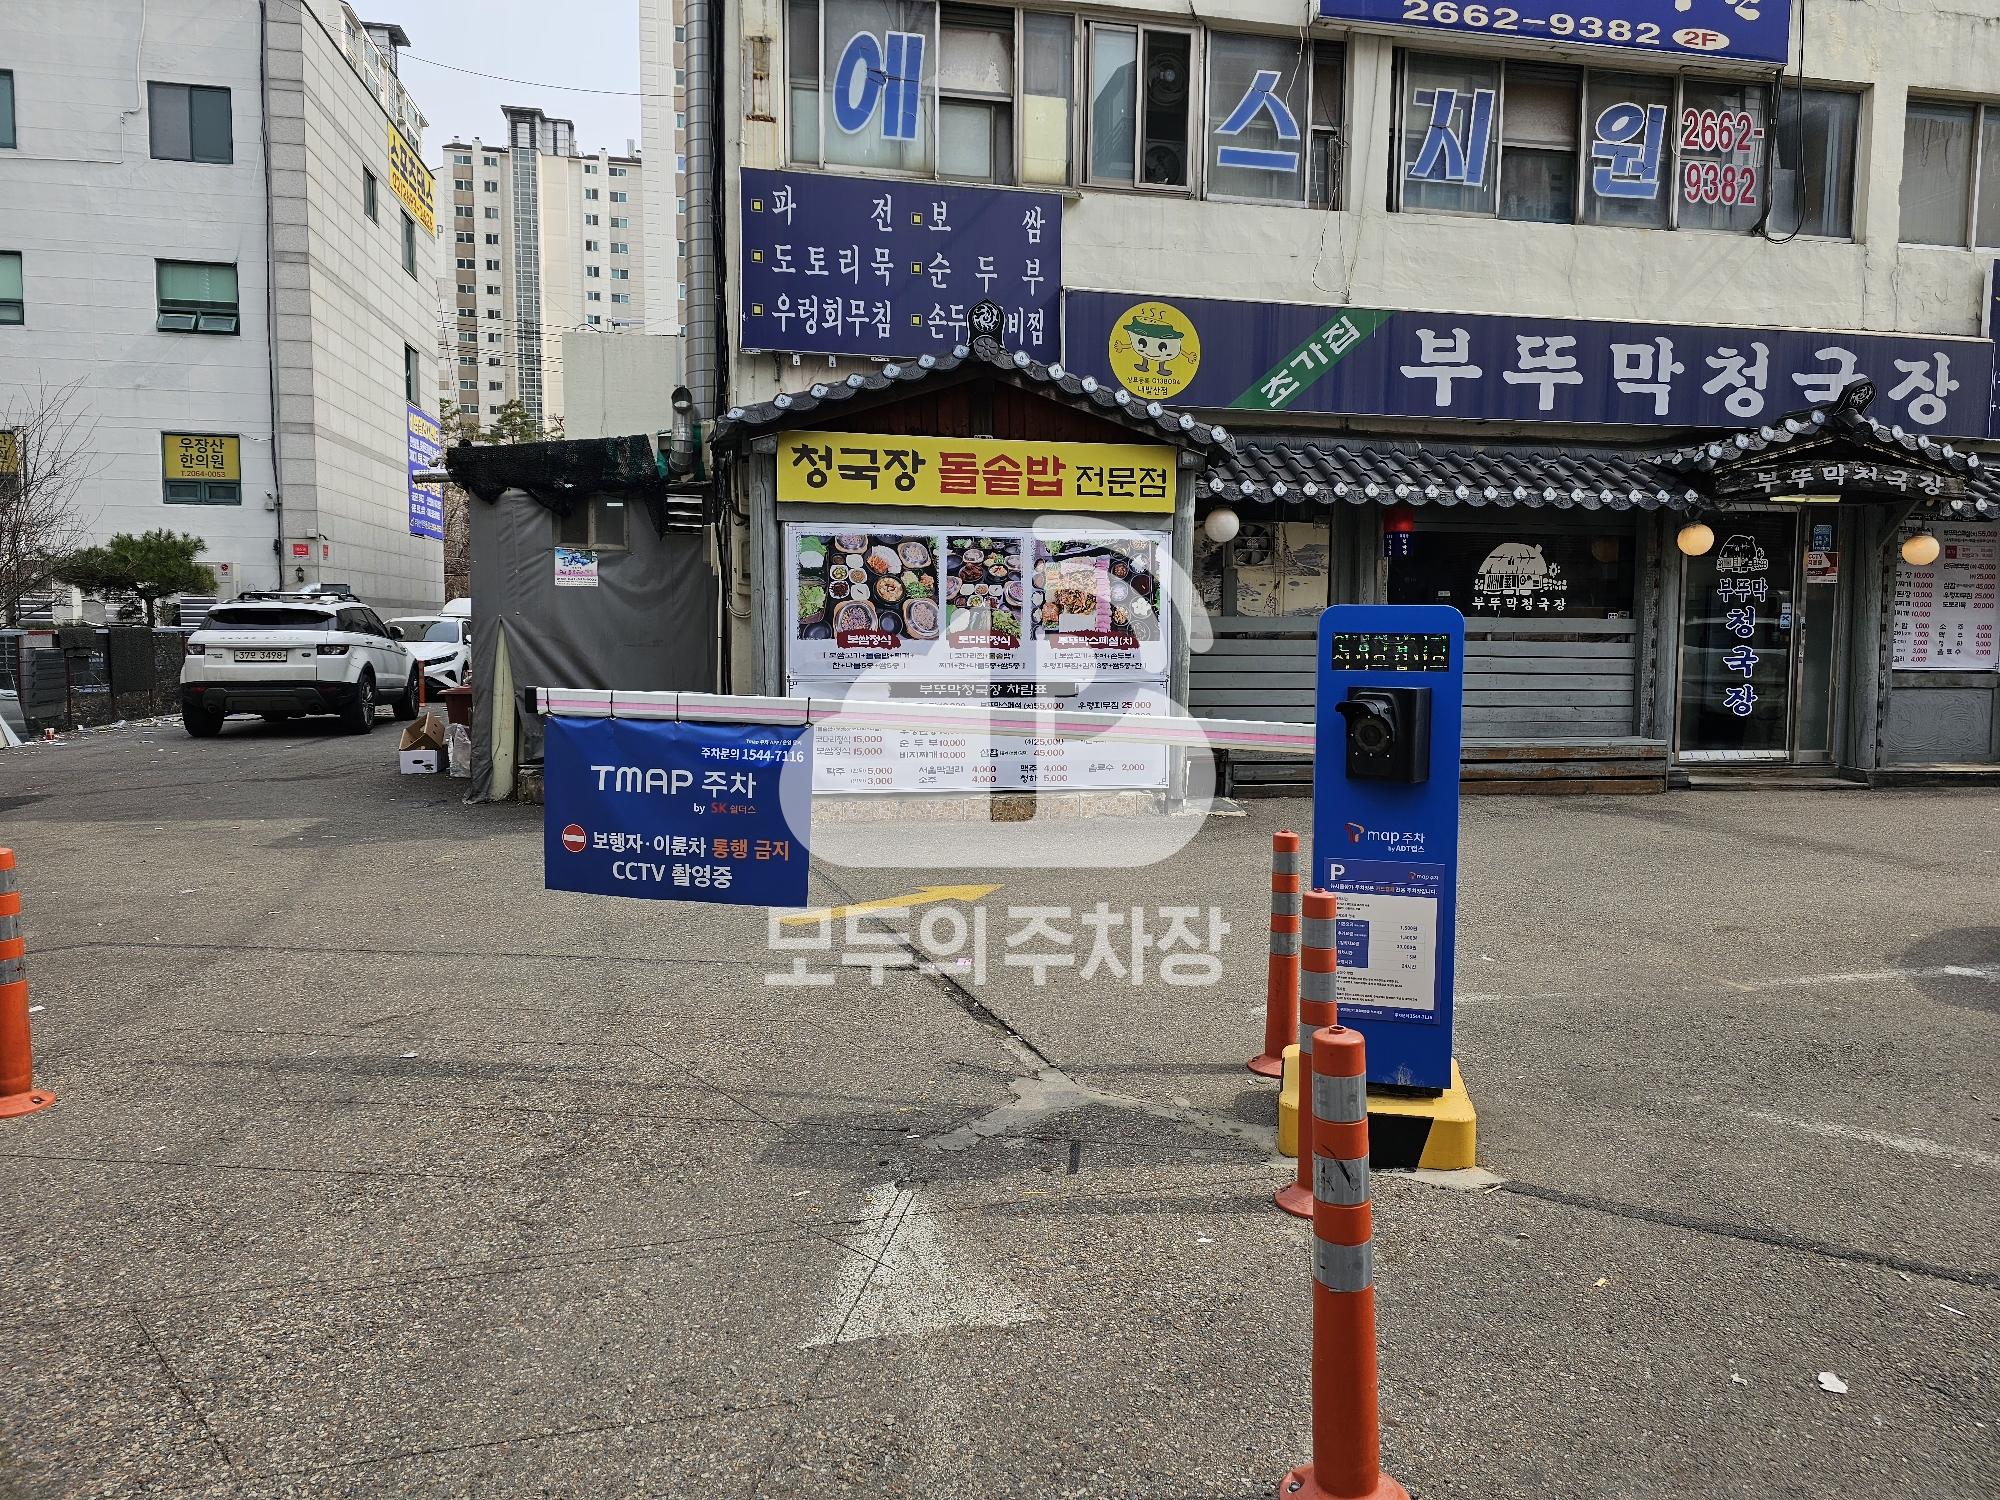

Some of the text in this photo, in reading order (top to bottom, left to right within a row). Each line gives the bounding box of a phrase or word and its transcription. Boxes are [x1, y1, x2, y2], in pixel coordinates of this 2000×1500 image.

[1402, 0, 1661, 45] 2662-9382
[1683, 30, 1719, 48] 2F
[1681, 108, 1764, 153] 2662-
[1685, 161, 1756, 206] 9382
[771, 245, 894, 286] 도토리묵
[772, 293, 891, 339] 우렁회무침
[1260, 316, 1360, 407] 초가집
[179, 438, 224, 453] 우장산
[180, 453, 224, 469] 한의원
[790, 443, 1168, 499] 청국장 돌솥밥 전문점
[1717, 577, 1768, 602] 부뚜막
[1472, 596, 1567, 611] 부뚜막청국장
[847, 635, 892, 645] 보쌈정식
[958, 635, 1011, 646] 코다리정식
[260, 652, 283, 660] 3498
[1723, 606, 1759, 716] 청국장
[919, 684, 1048, 697] 부뚜막청국장 차림표
[939, 739, 966, 747] 10,000
[701, 747, 804, 763] 주차문의 1544-7116
[853, 748, 882, 756] 15,000
[1020, 765, 1037, 773] 맥주
[591, 765, 757, 798] TMAP 주차
[1020, 775, 1037, 783] 청하
[694, 803, 705, 814] by
[711, 802, 727, 814] SK
[1402, 832, 1426, 844] 주차
[712, 838, 748, 859] 통행
[754, 839, 789, 861] 금지
[612, 860, 733, 888] CCTV 촬영중
[1330, 864, 1345, 880] P
